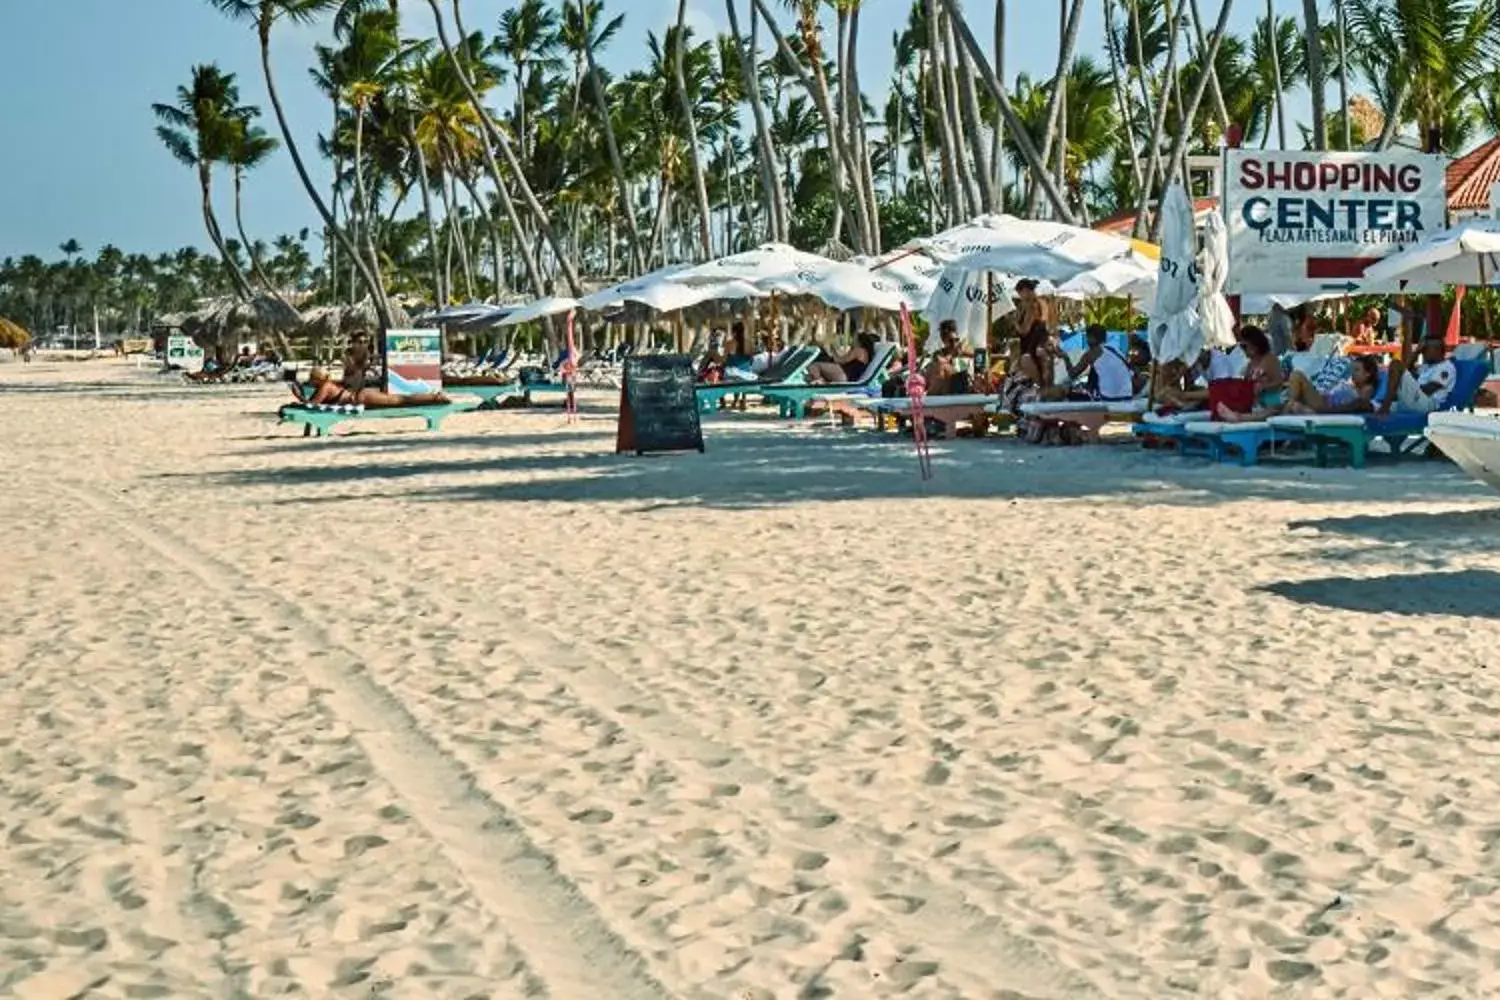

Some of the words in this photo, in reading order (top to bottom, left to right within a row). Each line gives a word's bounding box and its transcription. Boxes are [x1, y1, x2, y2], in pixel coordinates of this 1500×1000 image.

[1239, 159, 1421, 193] SHOPPING
[1242, 197, 1424, 230] CENTER
[1259, 229, 1294, 243] PLAZA
[1295, 229, 1358, 243] ARTESANAL
[1363, 230, 1376, 243] EL
[1379, 229, 1419, 243] PIRATA
